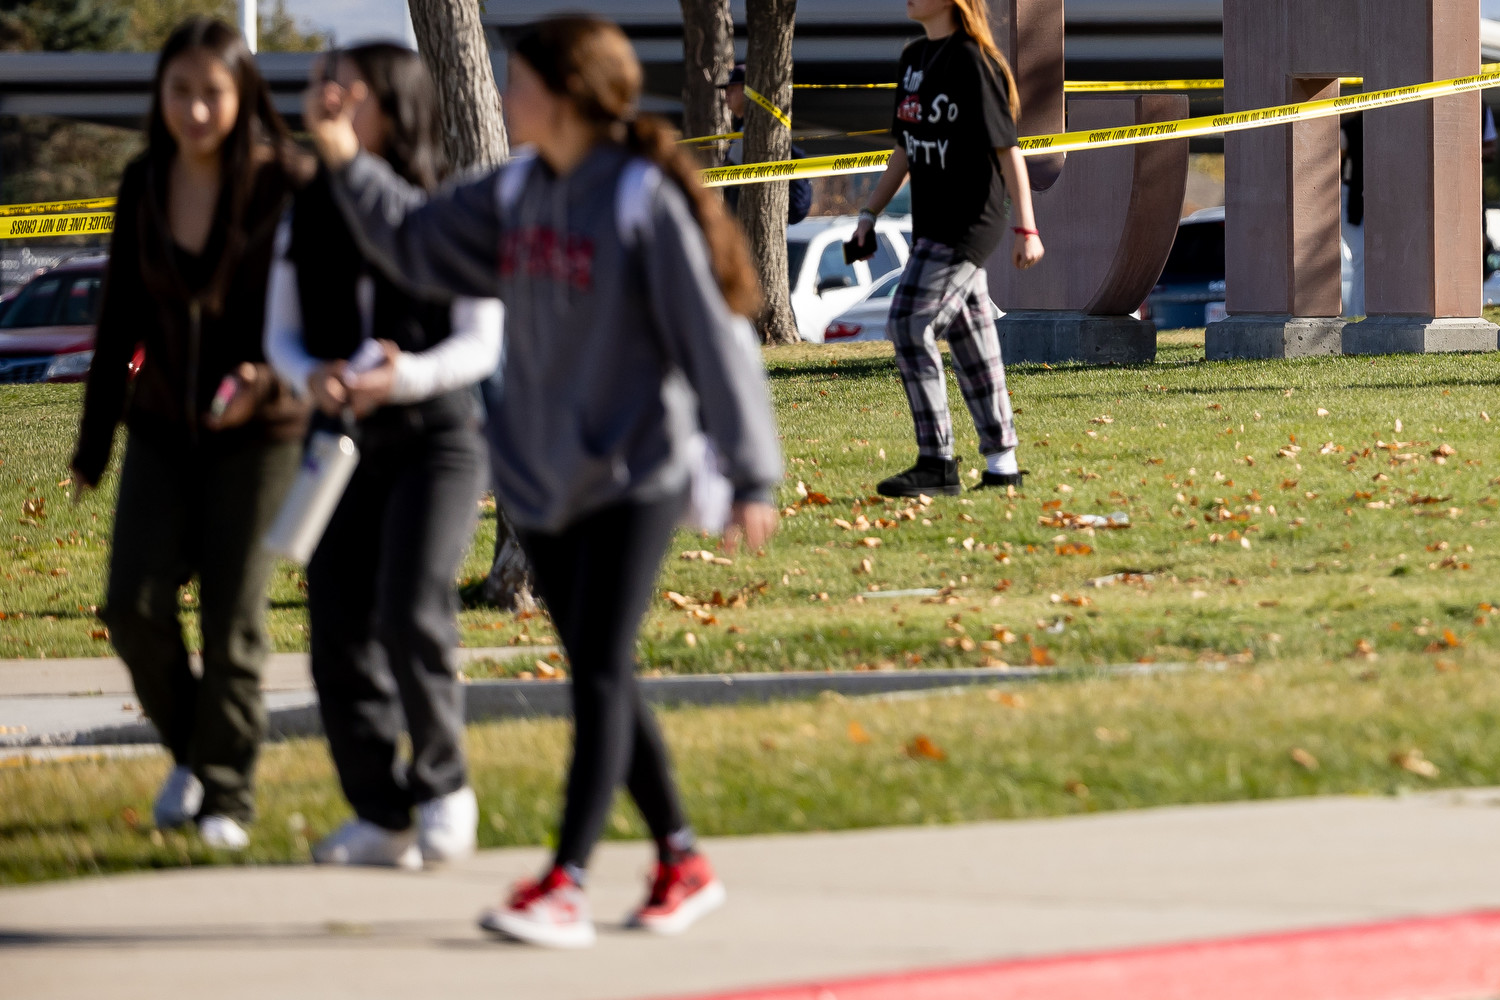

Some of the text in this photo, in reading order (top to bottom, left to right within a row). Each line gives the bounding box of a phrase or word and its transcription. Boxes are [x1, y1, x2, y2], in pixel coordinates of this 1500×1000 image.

[771, 162, 798, 177] POLICE
[832, 157, 858, 171] CROSS
[726, 169, 744, 181] NOT
[742, 167, 756, 180] DO
[754, 165, 773, 179] LINE
[10, 215, 116, 235] POLICE LINE DO NOT CROSS
